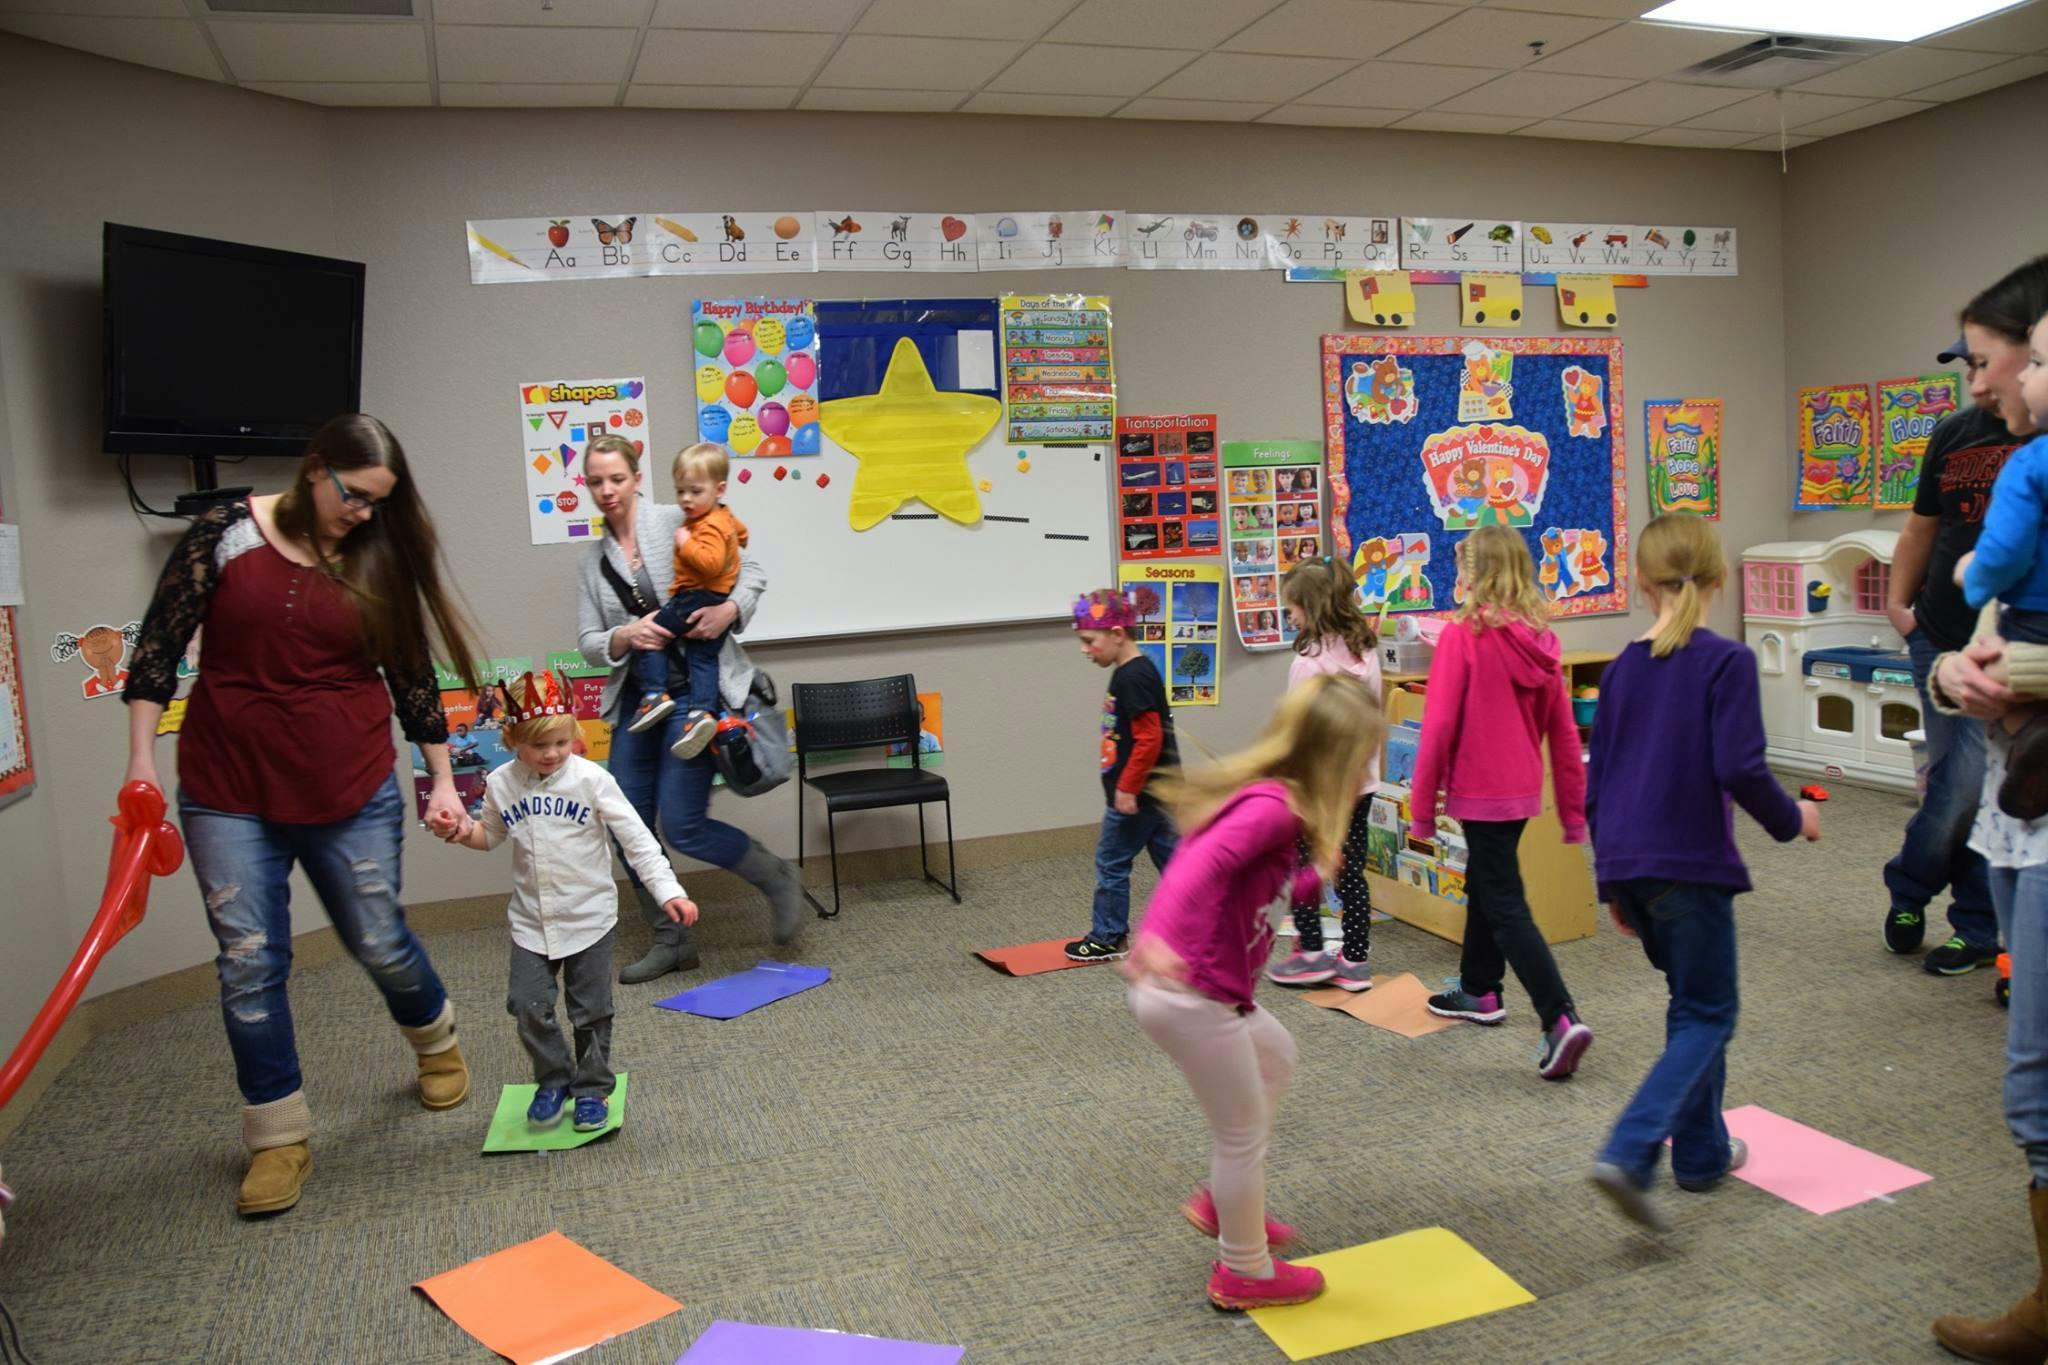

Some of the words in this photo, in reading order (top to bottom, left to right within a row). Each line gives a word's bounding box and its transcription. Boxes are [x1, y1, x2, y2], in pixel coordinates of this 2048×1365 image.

[545, 249, 576, 269] Aa
[602, 246, 630, 266] Bb
[662, 244, 691, 264] Cc
[719, 243, 746, 262] Dd
[776, 242, 800, 261] Ee
[833, 241, 857, 260] Ff
[883, 242, 912, 269] Gg
[940, 242, 966, 262] Hh
[999, 241, 1012, 260] Ii
[1042, 240, 1063, 265] Jj
[1093, 239, 1118, 257] Kk
[1185, 242, 1217, 260] Mm
[1236, 242, 1258, 260] Nn
[1324, 243, 1343, 267] Pp
[1409, 244, 1428, 260] Rr
[1451, 245, 1468, 262] Ss
[1492, 245, 1510, 263] Tt
[1530, 248, 1550, 265] Uu
[1569, 249, 1586, 264] Vv
[1602, 249, 1630, 265] Ww
[1646, 251, 1663, 267] Xx
[1679, 250, 1696, 272] Yy
[1712, 251, 1728, 267] Zz
[702, 301, 742, 318] Happy
[745, 300, 804, 317] Birthday!
[1021, 300, 1040, 310] Days
[1043, 313, 1069, 323] Sunday
[1045, 333, 1073, 344] Monday
[1041, 369, 1081, 378] Wednesday
[550, 383, 617, 405] shapes
[1046, 425, 1079, 433] Saturday
[1125, 417, 1209, 429] Transportation
[1889, 416, 1937, 443] Hop
[1811, 418, 1863, 448] Faith
[1667, 436, 1699, 455] Faith
[1253, 448, 1291, 461] Feelings
[1428, 446, 1463, 467] Happy
[1523, 448, 1544, 467] Day
[1667, 458, 1700, 475] Hope
[1669, 483, 1700, 497] Love
[557, 497, 577, 507] STOP
[1145, 567, 1195, 578] Seasons
[553, 659, 579, 670] How
[496, 666, 524, 677] Play
[584, 683, 598, 692] Put
[443, 704, 473, 717] gether
[500, 796, 591, 829] HANDSOME
